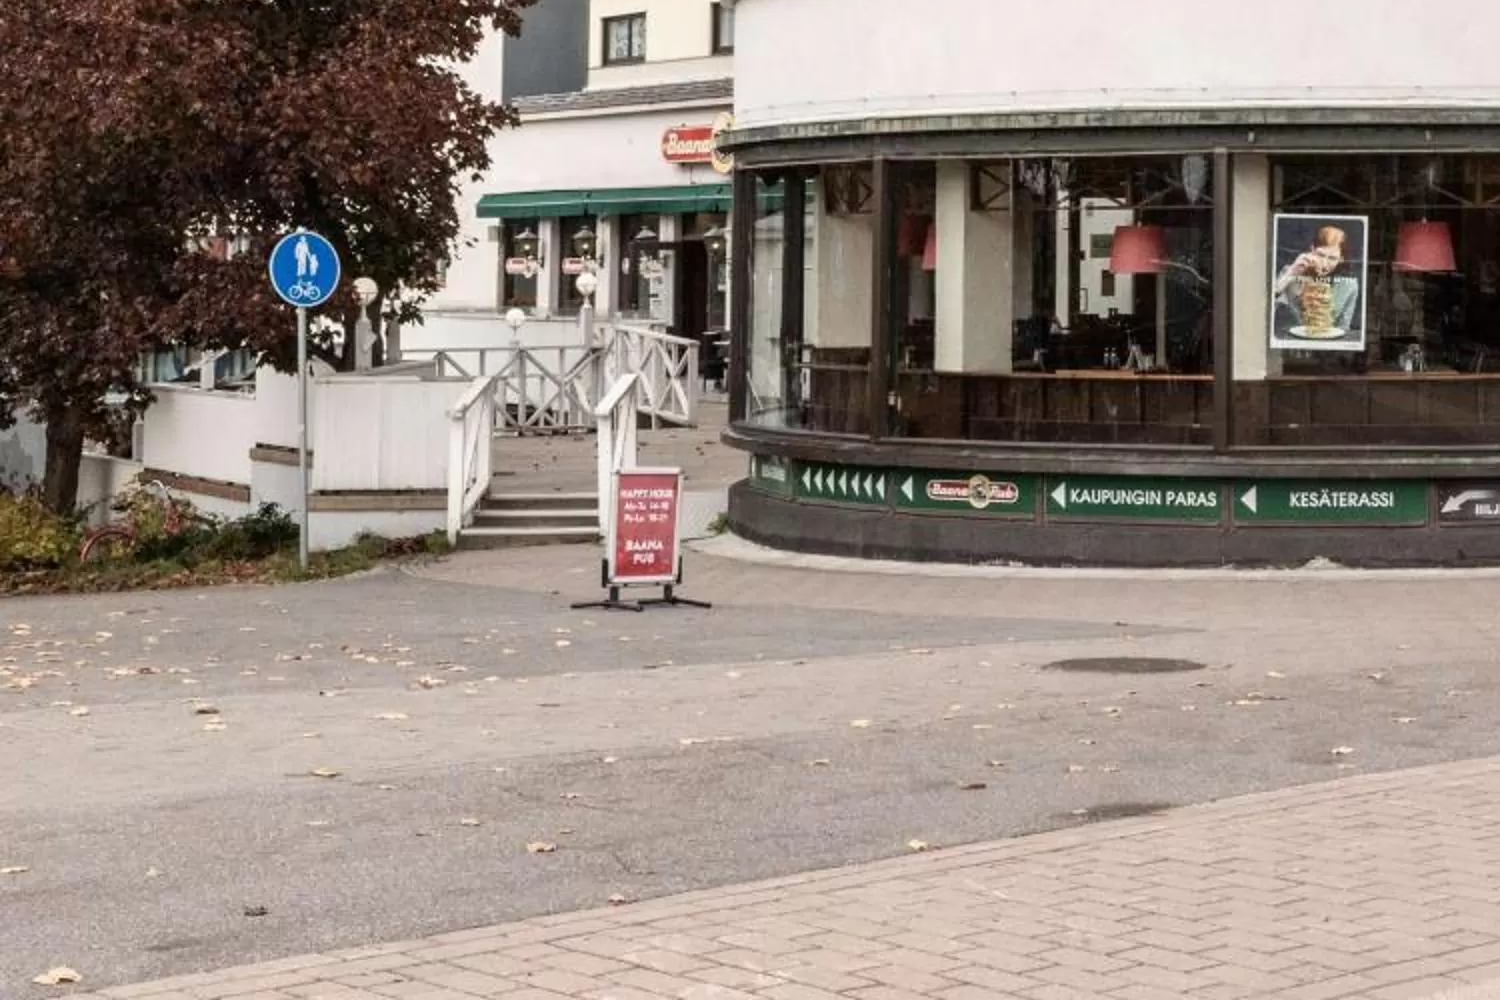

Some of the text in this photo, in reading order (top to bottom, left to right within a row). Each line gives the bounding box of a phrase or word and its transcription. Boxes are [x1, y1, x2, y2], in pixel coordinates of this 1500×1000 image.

[1070, 488, 1217, 508] KAUPUNGIN PARAS
[1289, 489, 1395, 508] KESÄTERASSI
